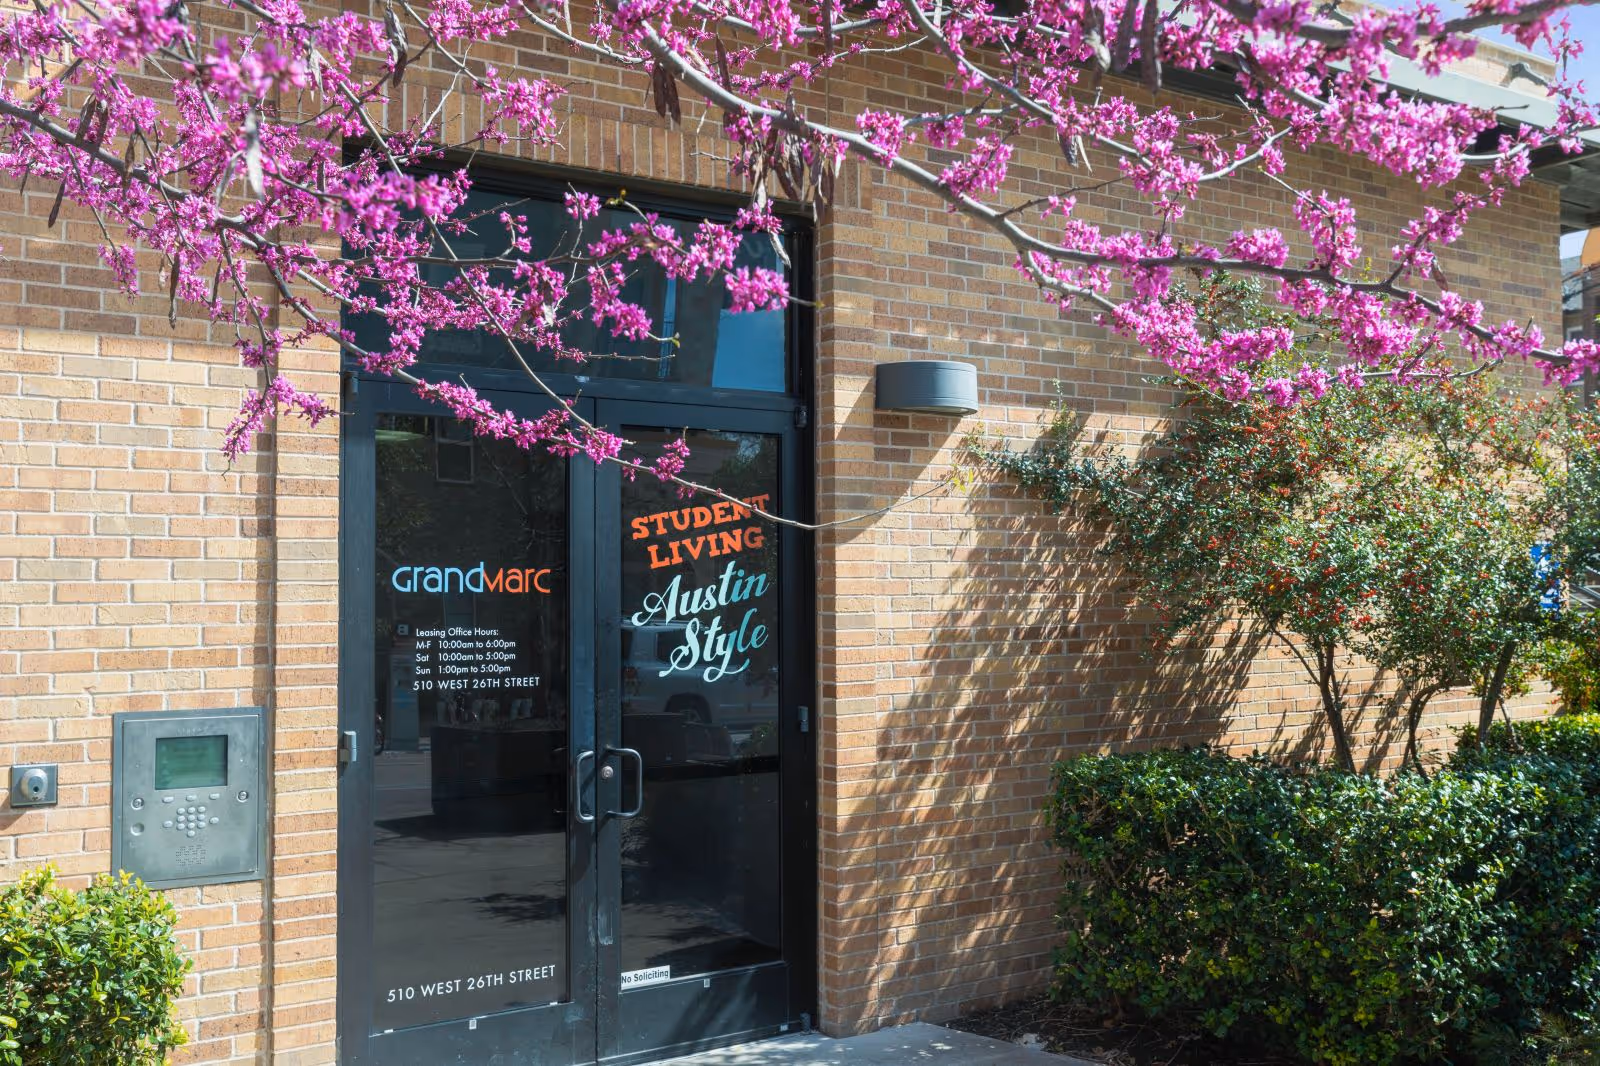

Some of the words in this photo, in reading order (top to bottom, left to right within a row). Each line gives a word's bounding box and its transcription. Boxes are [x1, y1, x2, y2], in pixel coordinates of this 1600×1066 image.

[630, 494, 771, 540] STUDENT
[647, 526, 767, 569] LIVING
[631, 560, 770, 627] Austin
[416, 628, 446, 638] Leasing
[448, 627, 472, 636] Office
[474, 628, 499, 636] Hours:
[416, 640, 432, 650] M-F
[438, 640, 474, 649] 10:00am
[486, 640, 516, 650] 6:00pm
[658, 607, 769, 683] Style
[416, 654, 430, 662] Sat
[438, 652, 474, 662] 10:00am
[486, 652, 516, 662] 5:00pm
[416, 666, 431, 675] Sun
[438, 665, 468, 675] 1:00pm
[480, 664, 511, 674] 5:00pm
[412, 680, 433, 690] 510
[438, 680, 468, 690] WEST
[472, 678, 500, 688] 26TH
[504, 676, 540, 688] STREET
[634, 970, 669, 982] Soliciting
[387, 987, 415, 1003] 510
[420, 980, 462, 998] WEST
[467, 973, 503, 990] 26TH
[509, 964, 556, 984] STREET
